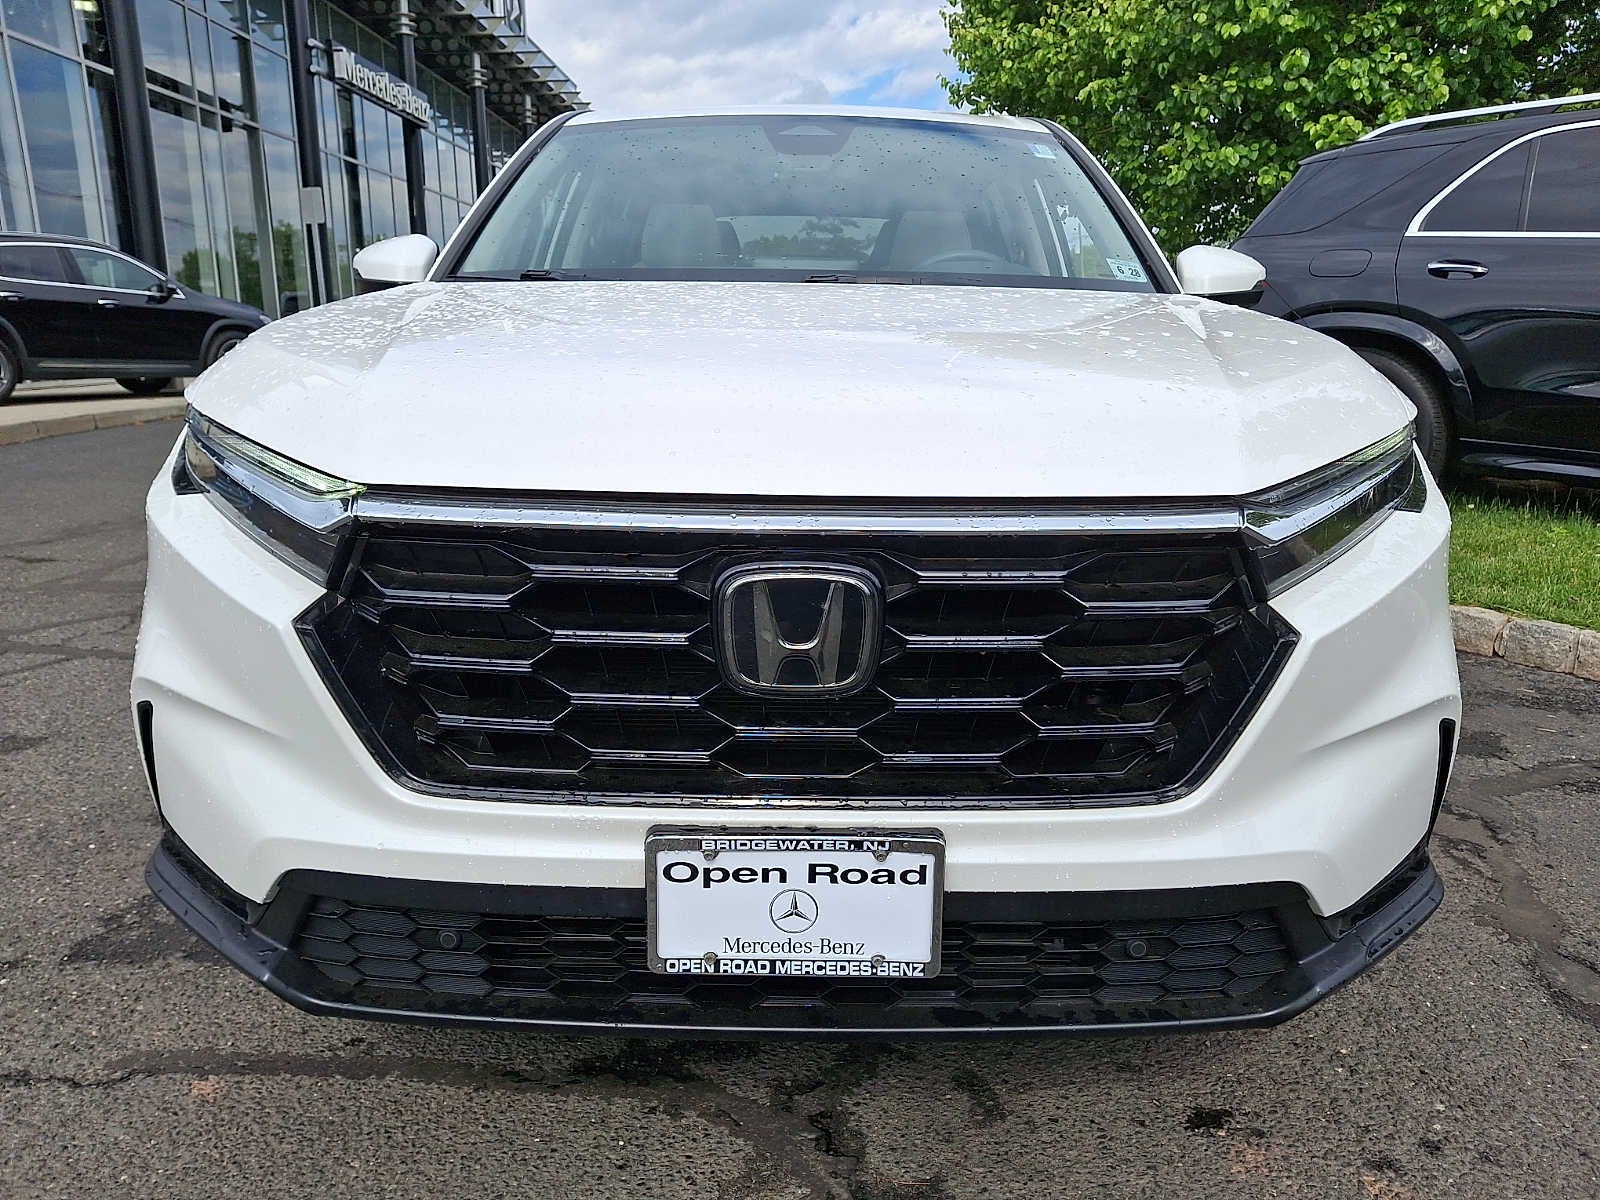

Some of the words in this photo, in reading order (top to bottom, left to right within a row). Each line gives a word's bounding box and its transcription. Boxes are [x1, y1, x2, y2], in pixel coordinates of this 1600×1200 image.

[344, 51, 430, 121] Mercedes-Benz
[1117, 265, 1124, 275] 6
[863, 841, 890, 851] NJ
[662, 861, 788, 889] Open
[807, 863, 928, 885] Road
[723, 937, 865, 956] Mercedes-Benz
[666, 959, 715, 973] OPEN
[720, 959, 770, 974] ROAD
